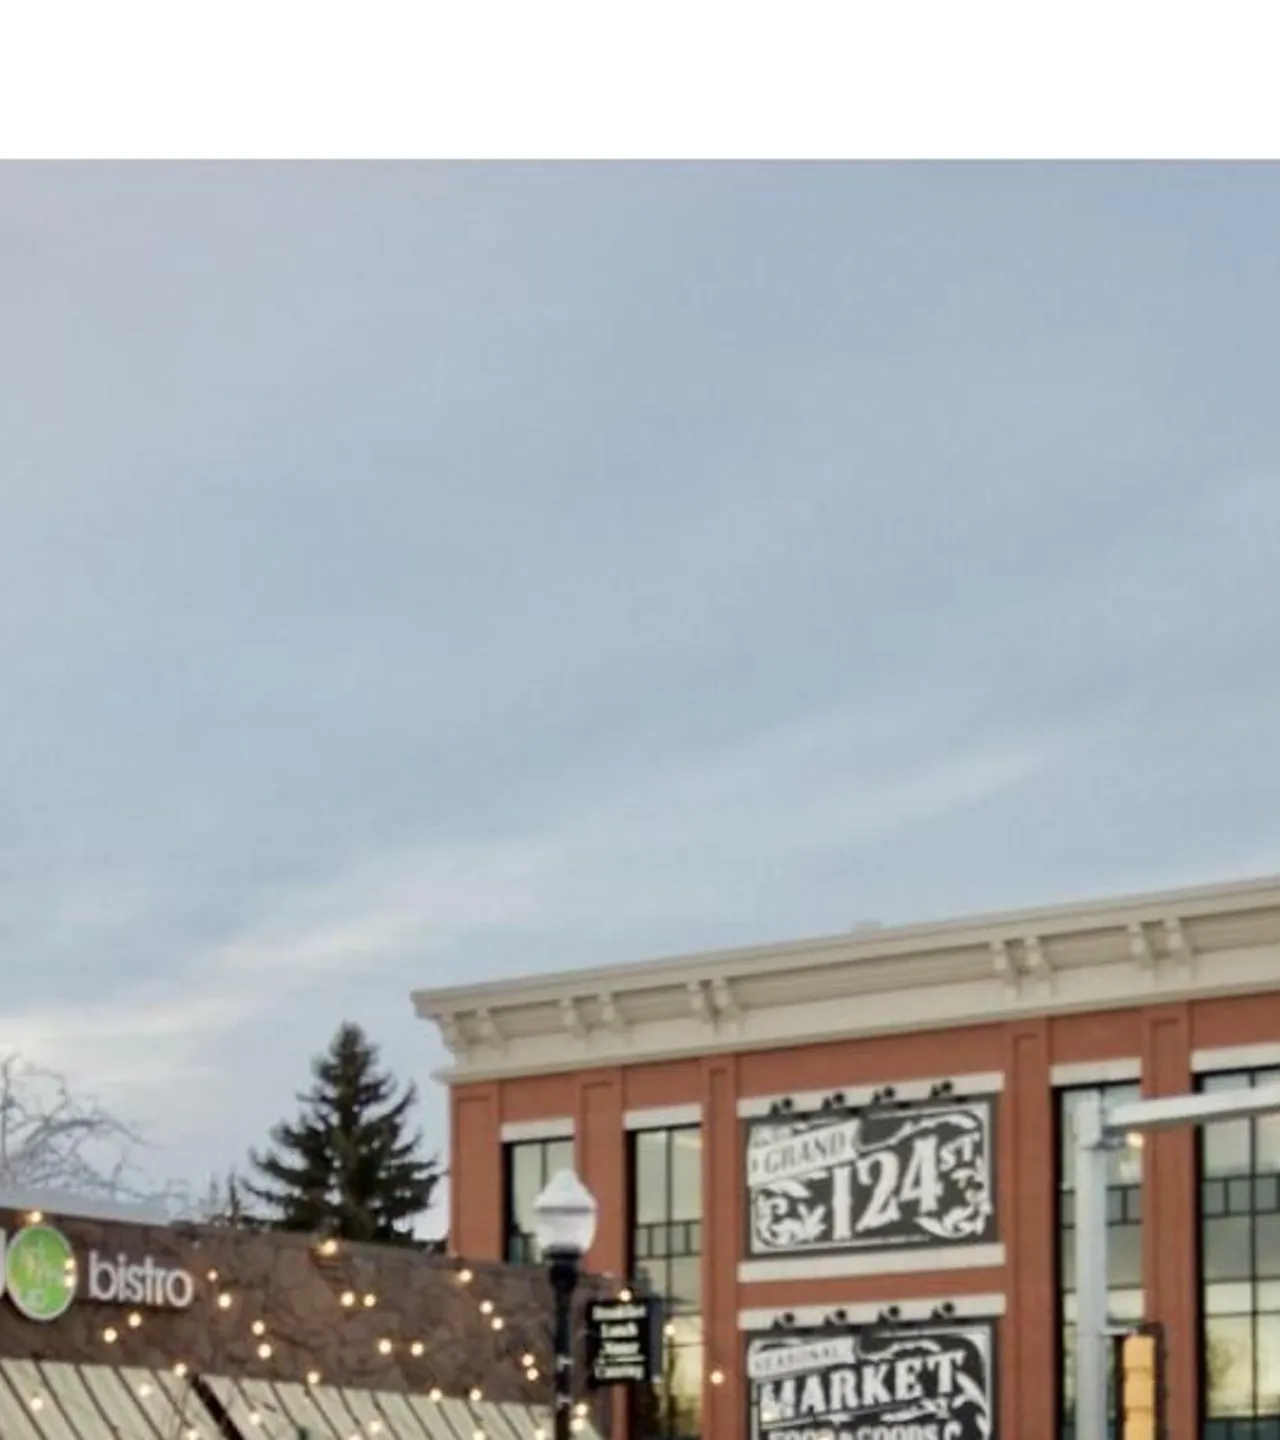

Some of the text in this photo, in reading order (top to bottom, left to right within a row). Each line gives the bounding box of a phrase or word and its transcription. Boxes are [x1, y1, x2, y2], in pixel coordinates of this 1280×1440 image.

[765, 1131, 847, 1174] GRAND
[831, 1131, 981, 1241] 124 ST
[88, 1249, 194, 1308] bistro
[759, 1349, 967, 1423] MARKET
